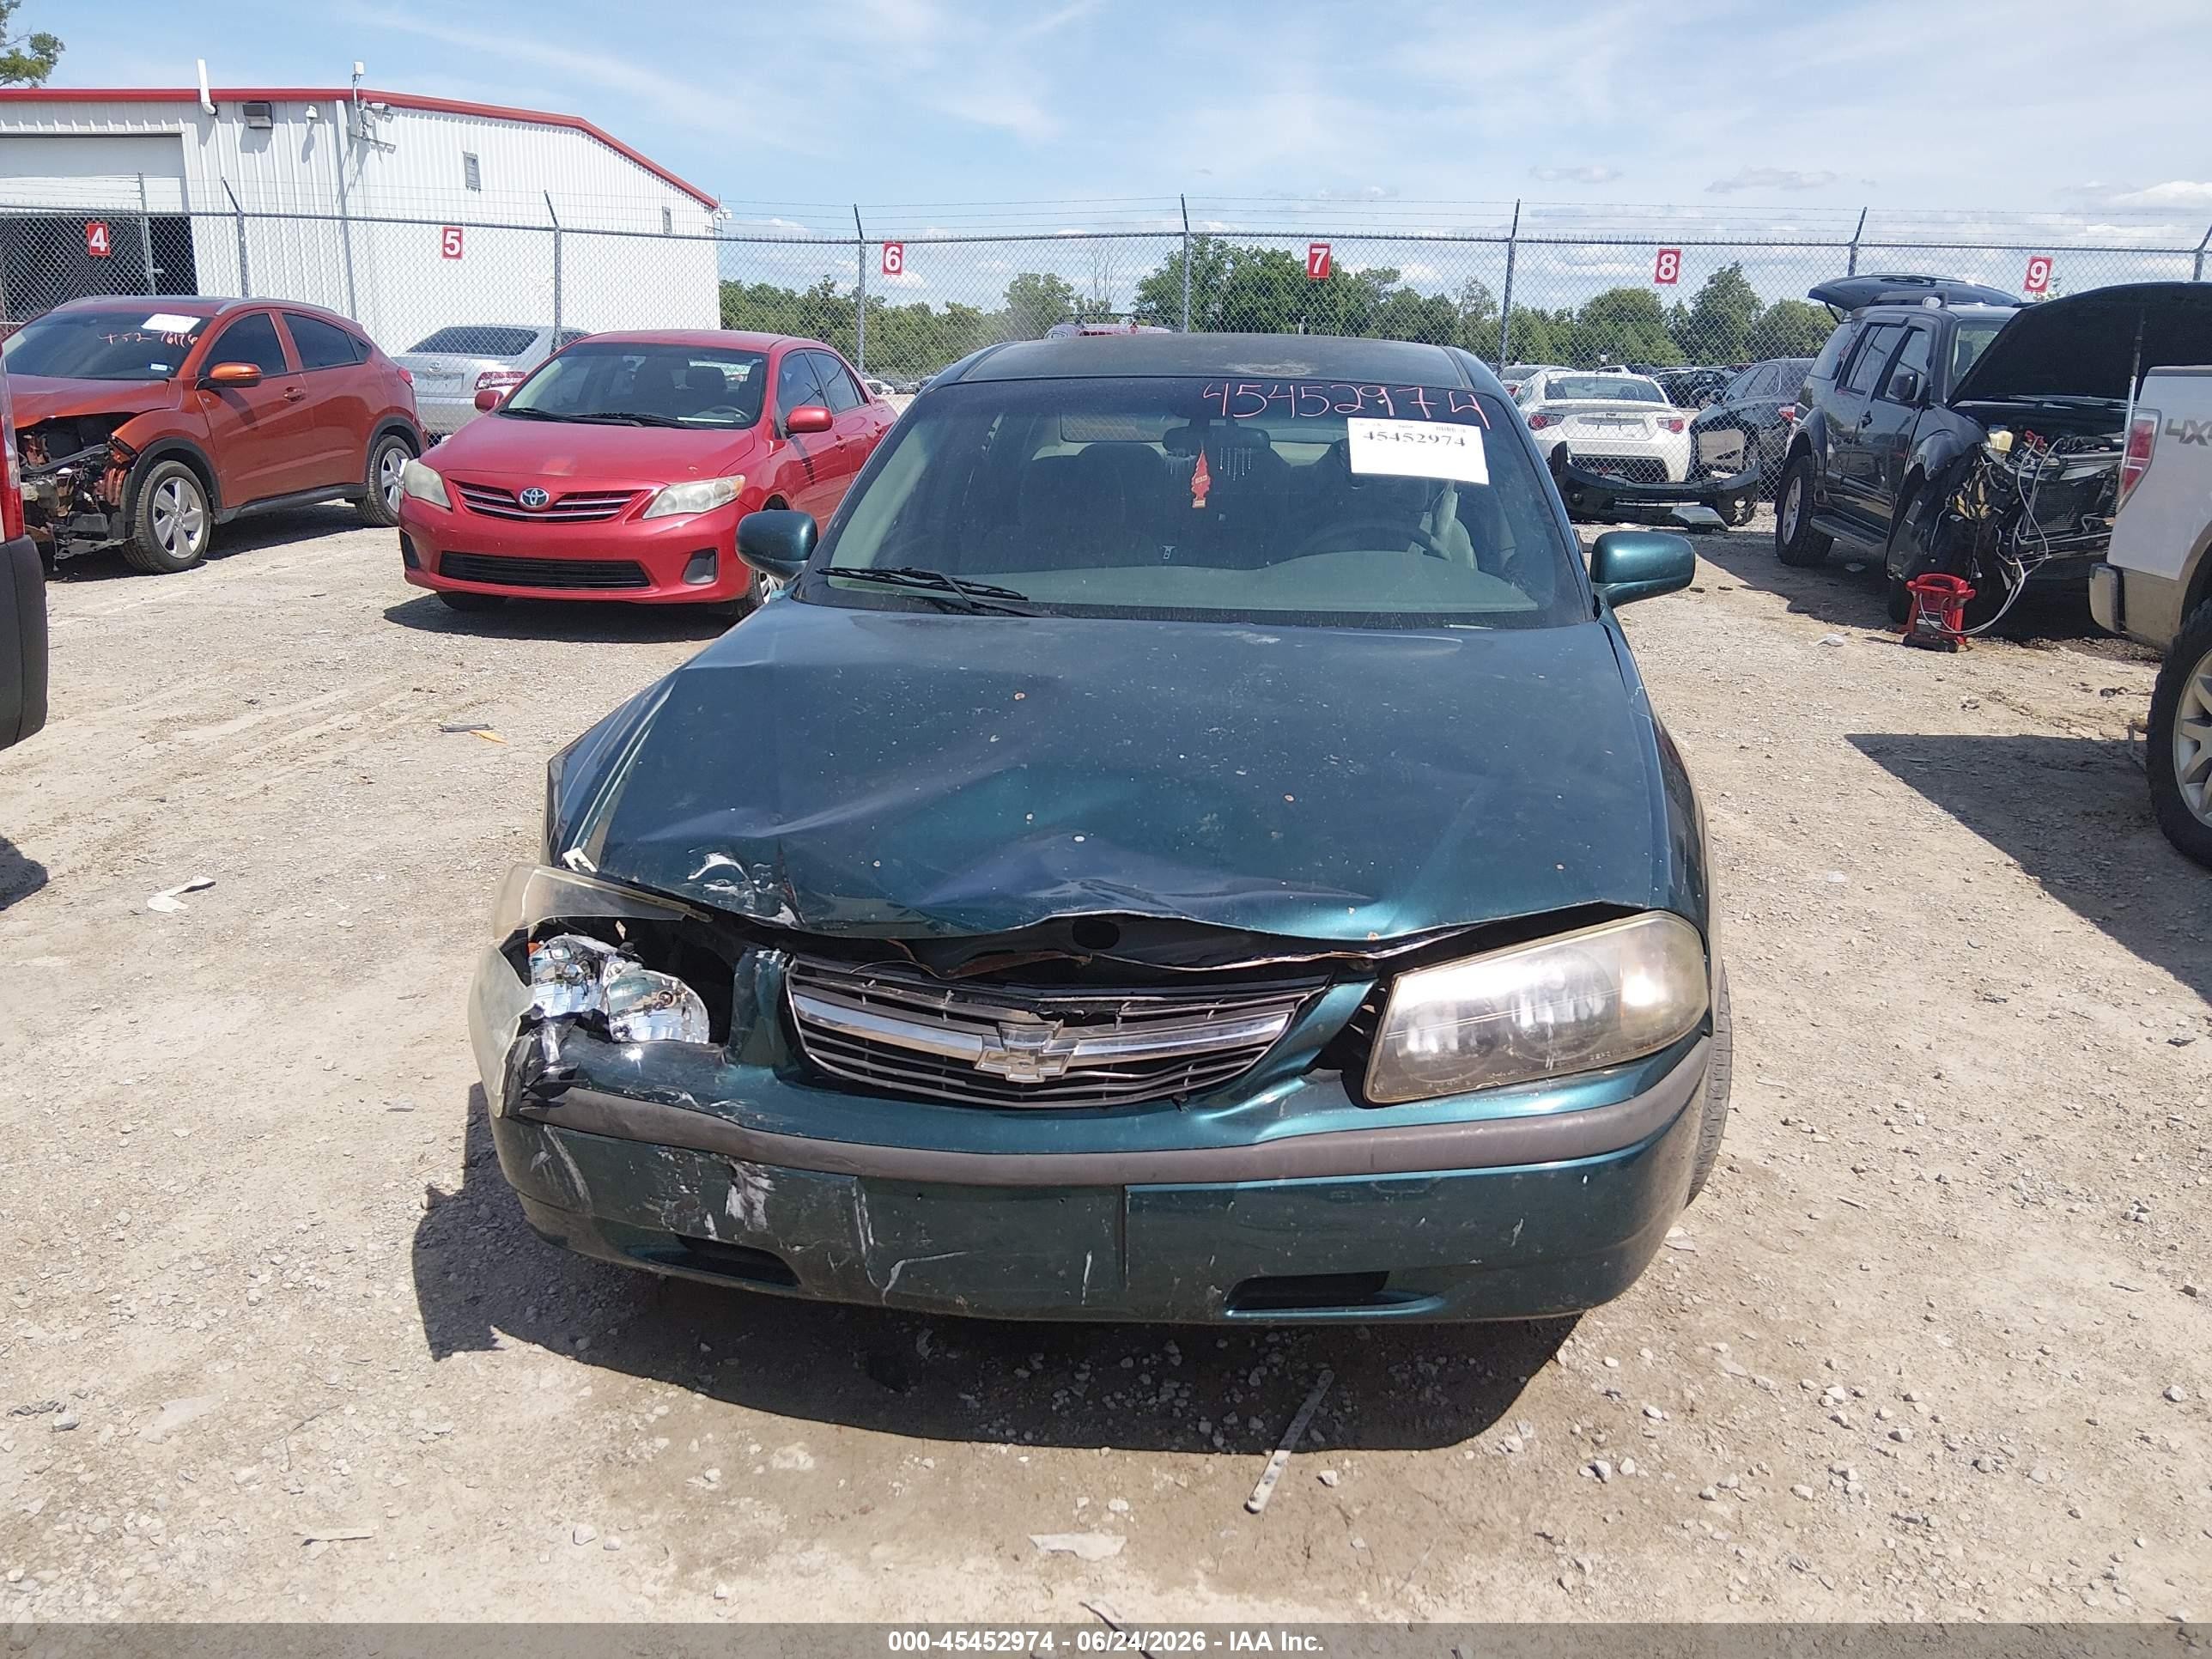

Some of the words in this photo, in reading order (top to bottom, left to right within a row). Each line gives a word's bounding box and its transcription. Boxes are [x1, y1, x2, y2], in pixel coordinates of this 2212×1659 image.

[91, 227, 107, 252] 4
[443, 231, 461, 256] 5
[884, 246, 901, 271] 6
[1311, 248, 1328, 274] 7
[1658, 253, 1677, 280] 8
[2028, 261, 2049, 288] 9
[1203, 383, 1491, 430] 45452974
[1363, 431, 1466, 447] 45452974
